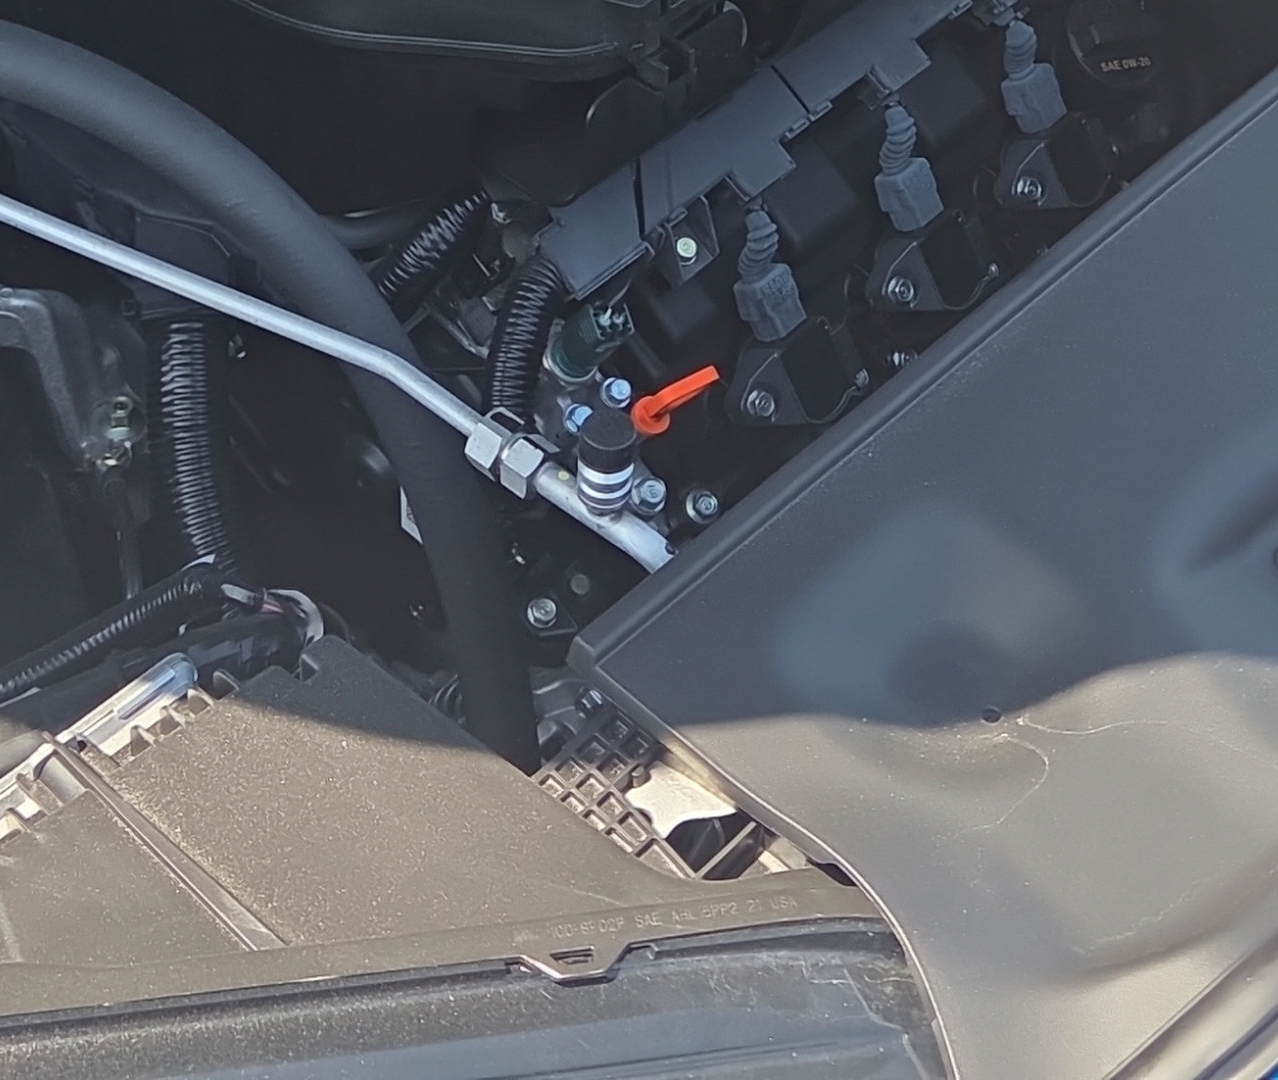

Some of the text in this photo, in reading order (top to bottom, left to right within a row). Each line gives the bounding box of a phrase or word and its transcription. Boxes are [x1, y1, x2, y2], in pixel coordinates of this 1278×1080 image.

[1100, 60, 1122, 72] SAE
[634, 910, 659, 928] SAE
[769, 895, 799, 910] USA
